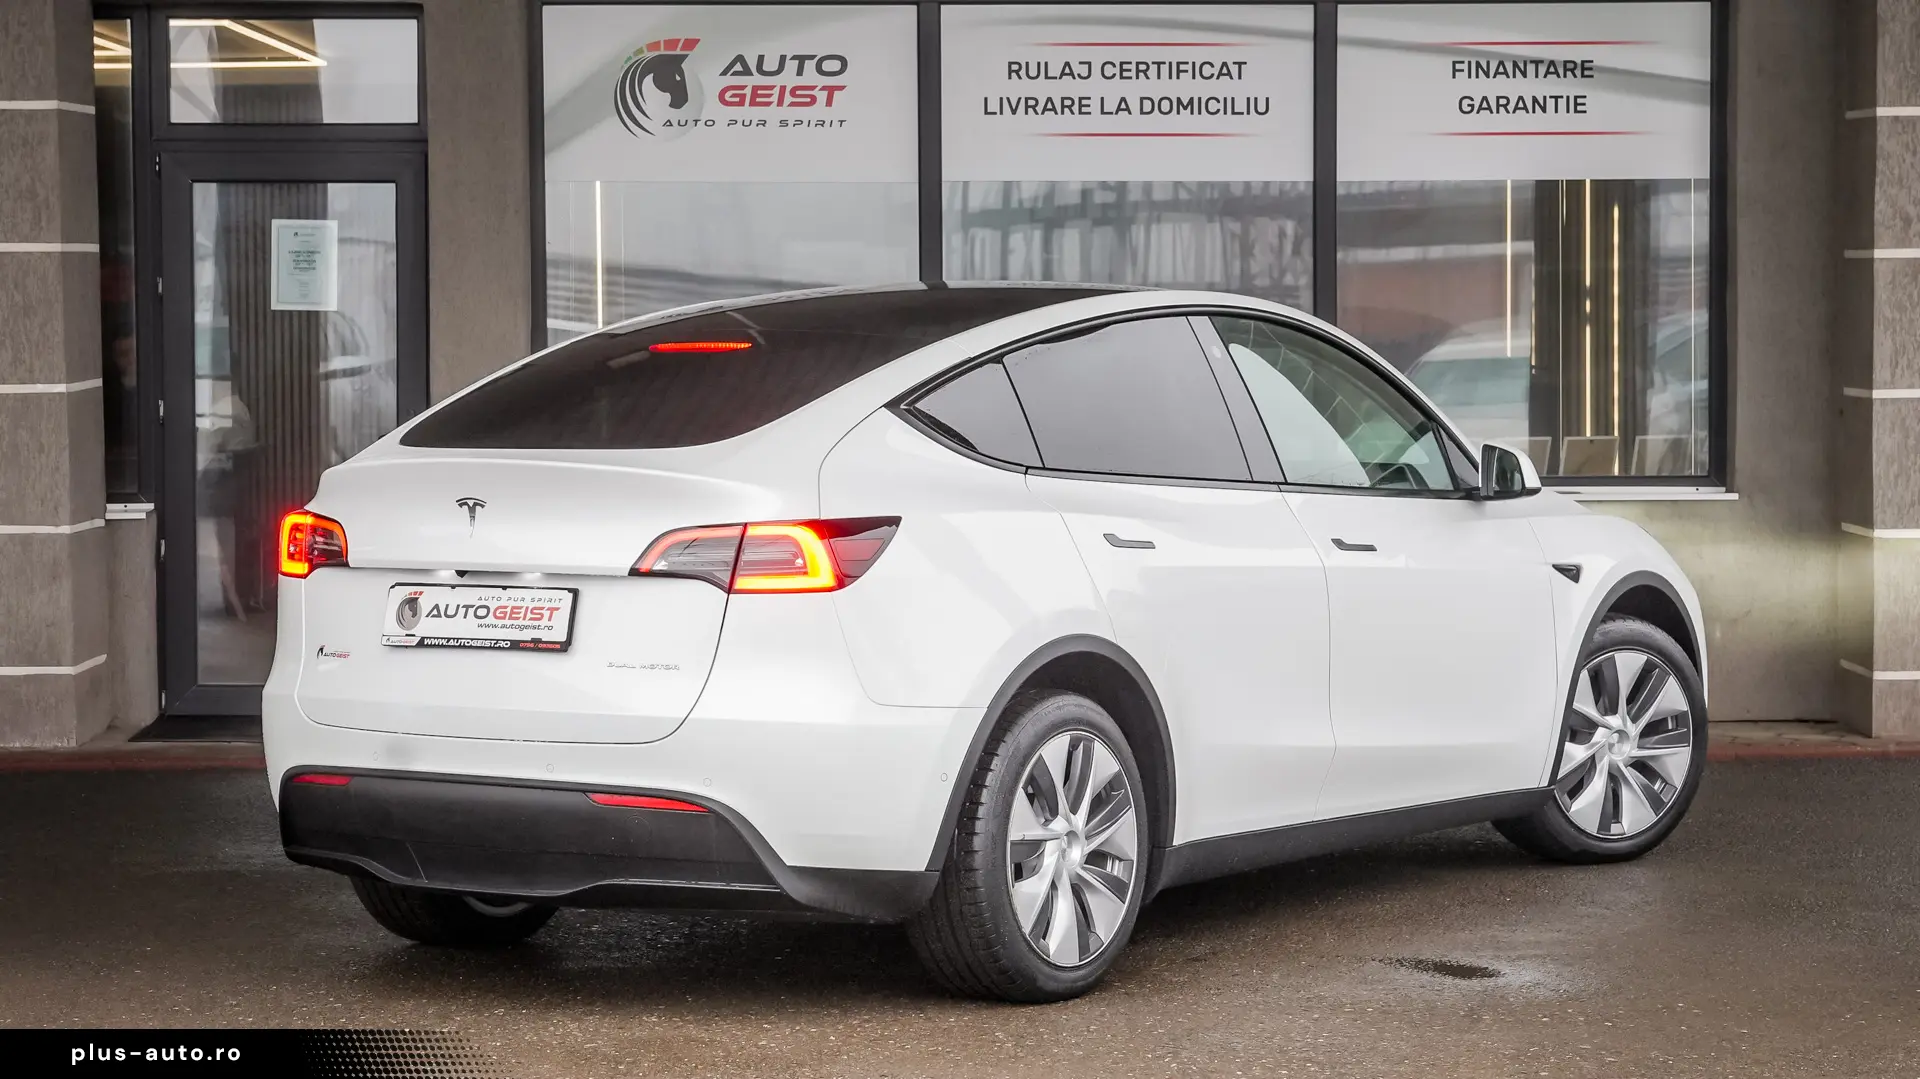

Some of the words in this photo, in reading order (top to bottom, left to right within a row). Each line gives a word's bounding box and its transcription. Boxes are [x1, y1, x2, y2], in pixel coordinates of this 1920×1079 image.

[719, 54, 848, 77] AUTO
[1007, 61, 1092, 80] RULAJ
[1100, 61, 1247, 80] CERTIFICAT
[1452, 60, 1594, 79] FINANTARE
[718, 85, 847, 107] GEIST
[1458, 95, 1587, 114] GARANTIE
[984, 97, 1092, 116] LIVRARE
[1100, 97, 1132, 116] LA
[1139, 97, 1270, 116] DOMICILIU
[662, 119, 716, 128] AUTO
[727, 119, 768, 128] PUR
[778, 119, 847, 128] SPIRIT
[477, 622, 554, 632] www.autogeist.ro
[424, 638, 511, 648] WWW.AUTOGEIST.RO
